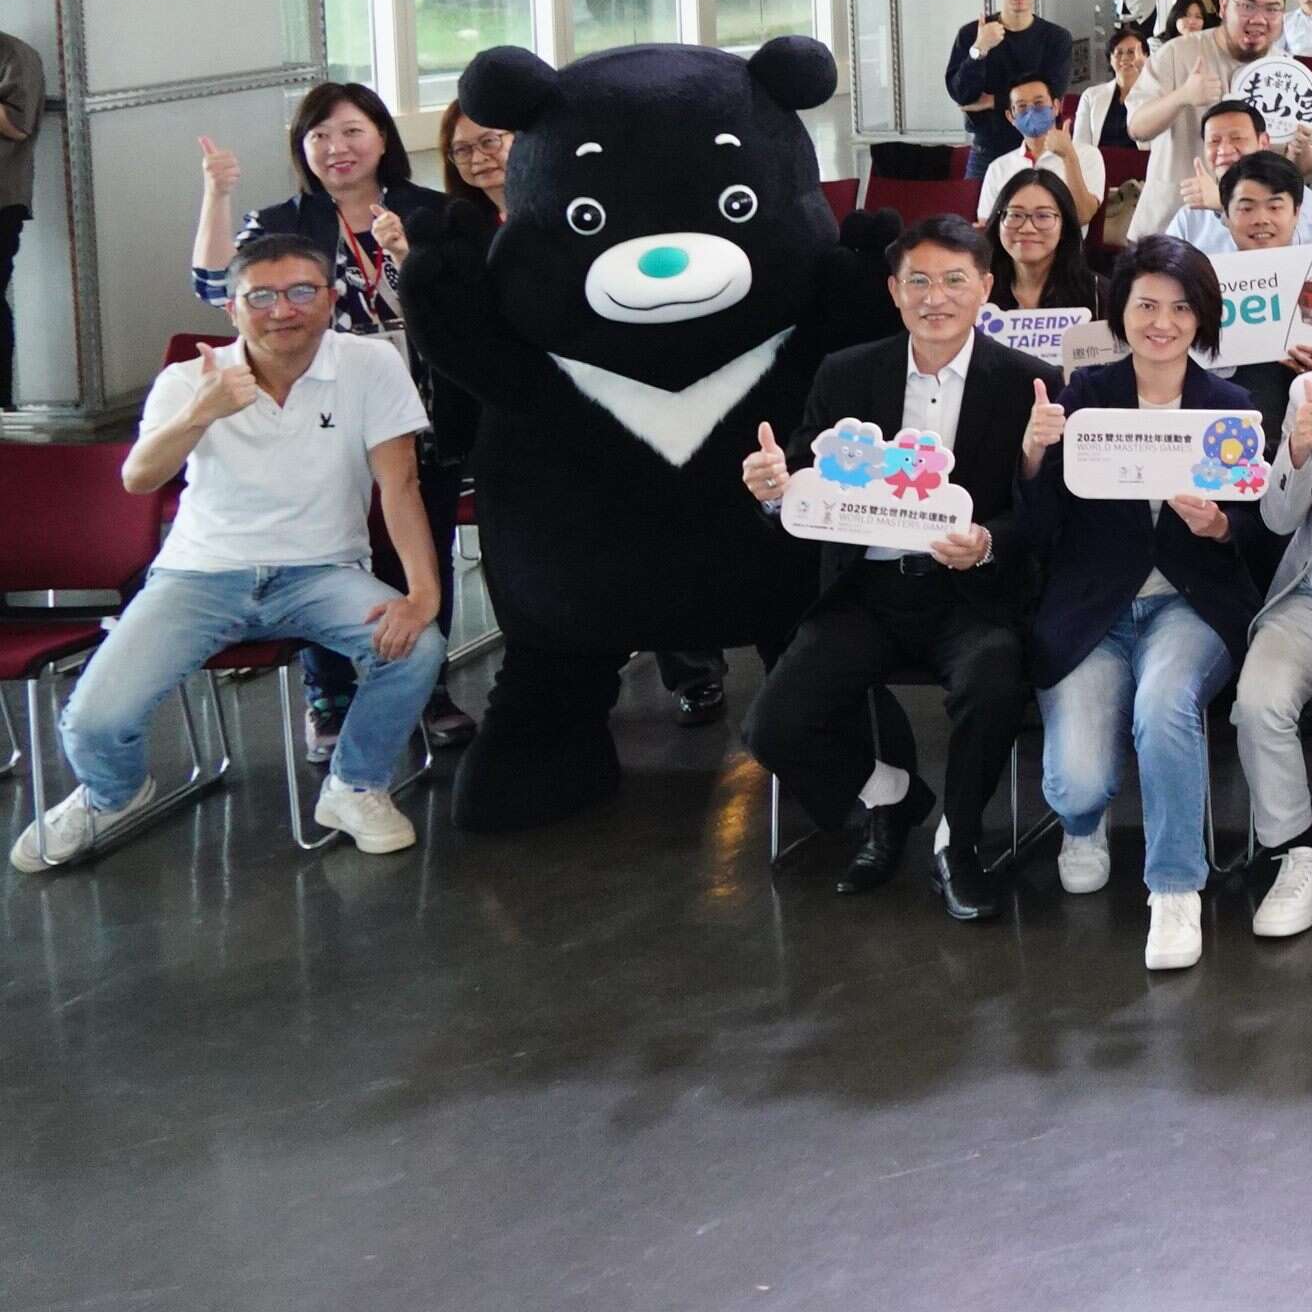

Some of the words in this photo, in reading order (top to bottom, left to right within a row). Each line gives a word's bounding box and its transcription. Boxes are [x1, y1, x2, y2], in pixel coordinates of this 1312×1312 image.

[1077, 433, 1192, 444] 2025雙北世界壯年運動會
[840, 502, 957, 524] 2025雙北世界壯年運動會
